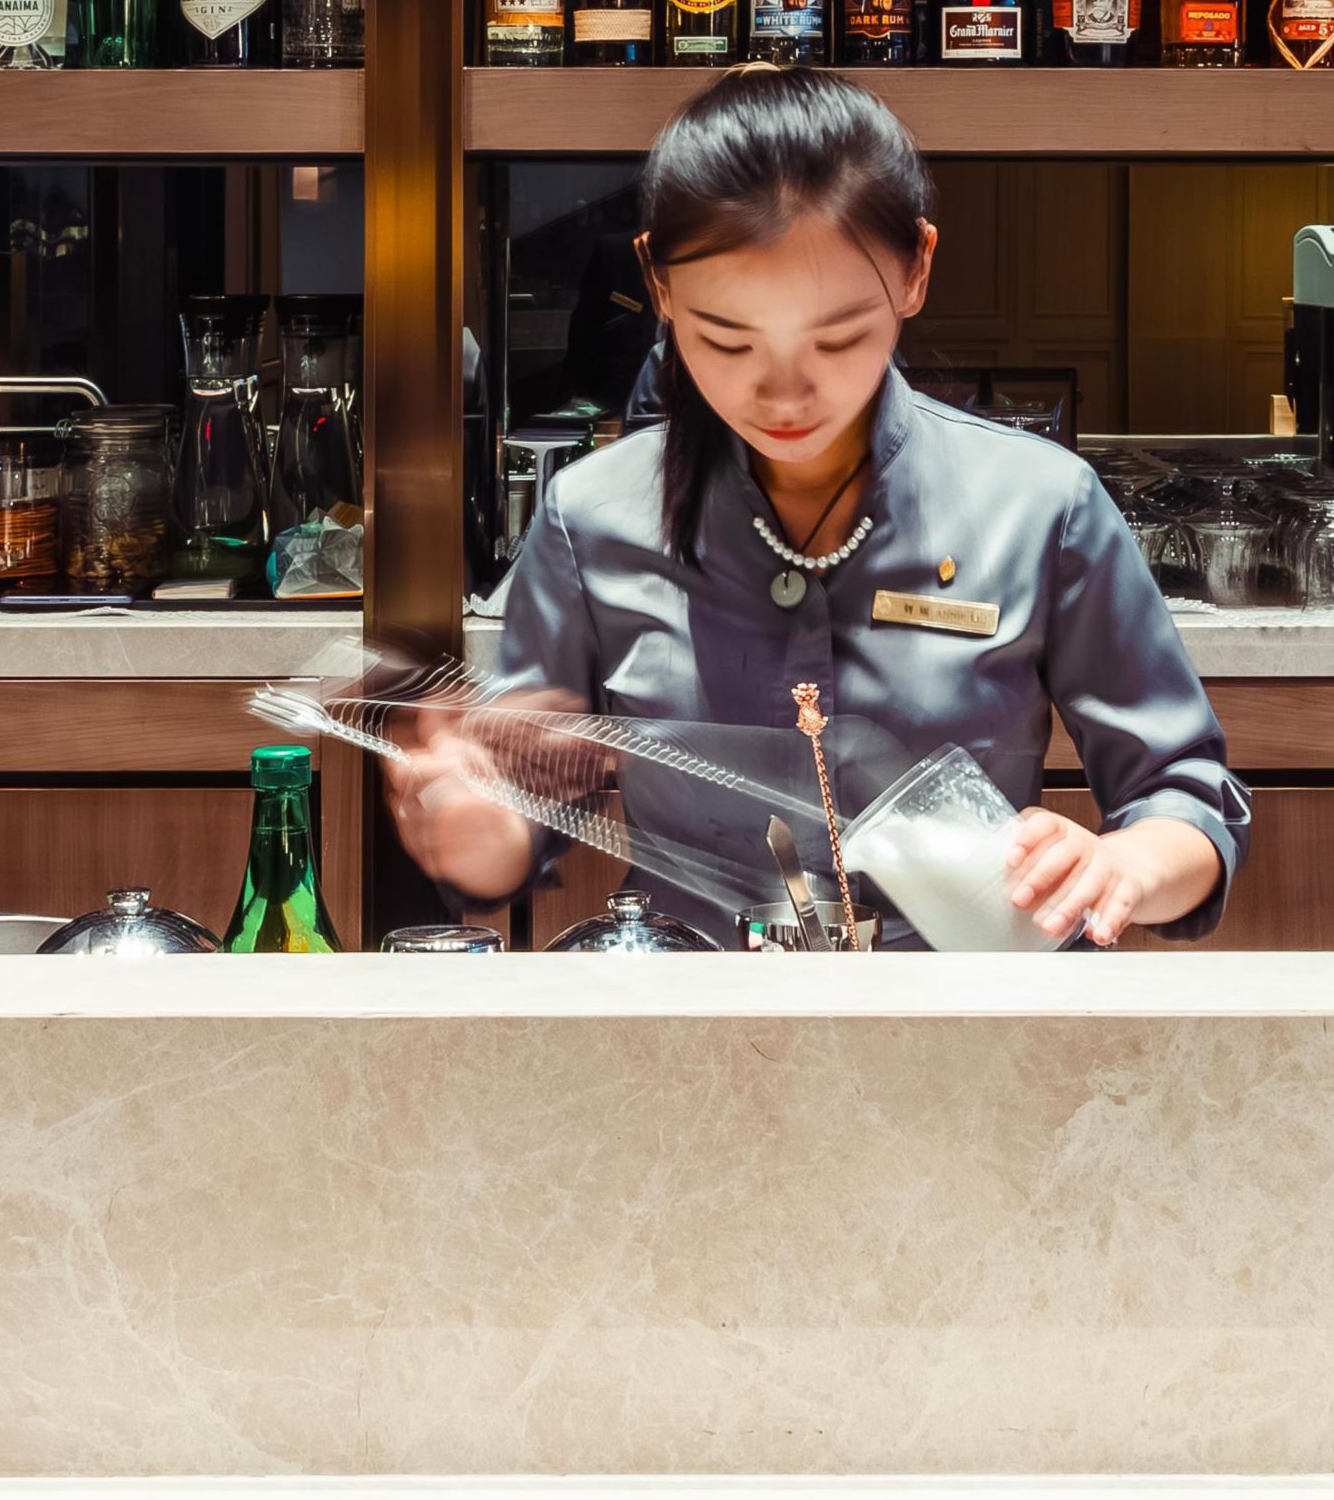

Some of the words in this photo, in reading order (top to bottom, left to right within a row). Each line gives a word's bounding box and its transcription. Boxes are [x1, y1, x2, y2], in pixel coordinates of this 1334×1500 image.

[201, 6, 228, 14] GIN
[763, 15, 796, 26] WHITE
[851, 14, 879, 24] DARK
[882, 14, 904, 24] RUM
[1188, 11, 1231, 20] REPOSADO
[949, 24, 976, 38] Grand
[977, 24, 1014, 36] Marnier
[1318, 24, 1328, 36] 5
